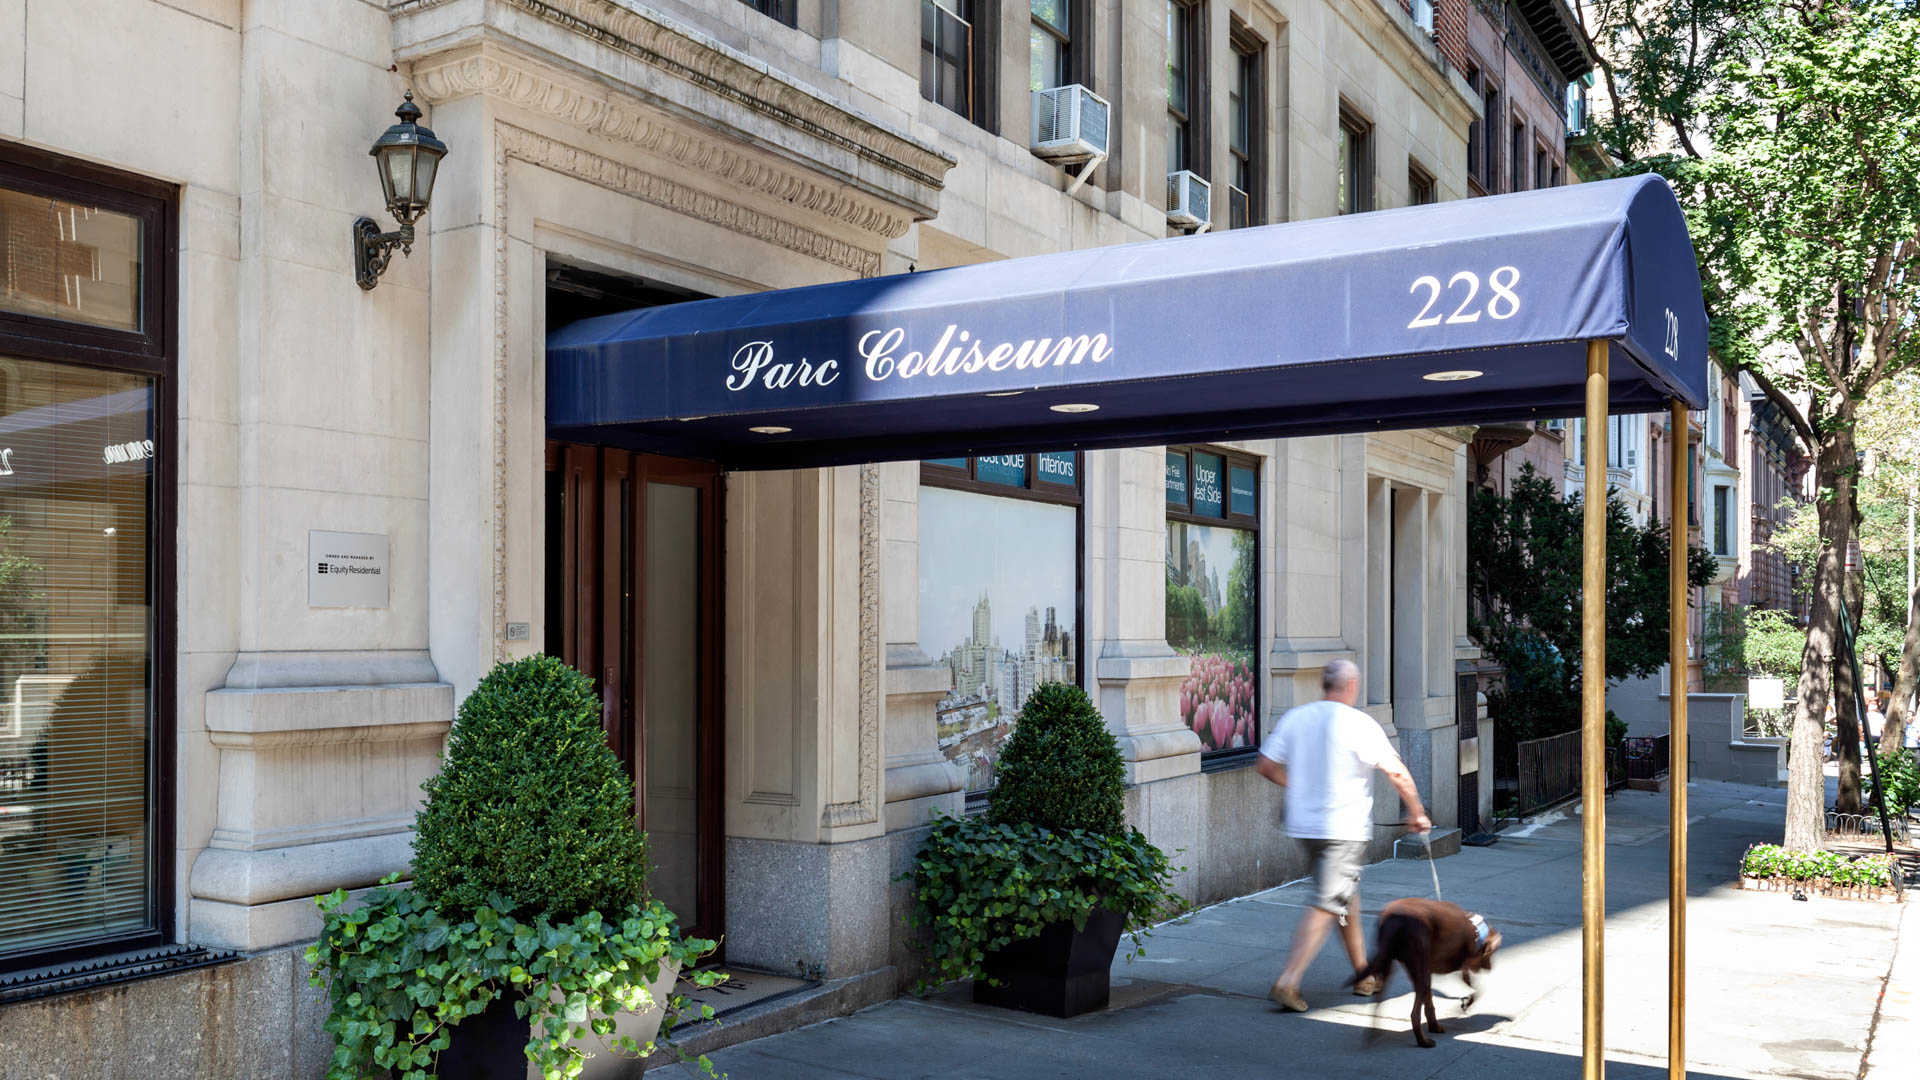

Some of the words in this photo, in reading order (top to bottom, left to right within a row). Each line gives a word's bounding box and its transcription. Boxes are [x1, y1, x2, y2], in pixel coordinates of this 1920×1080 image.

[1407, 266, 1521, 329] 228
[1665, 307, 1679, 361] 228
[726, 340, 839, 391] Parc
[858, 325, 1113, 381] Coliseum
[1039, 453, 1073, 477] Interiors
[1195, 463, 1217, 486] Upper
[1194, 484, 1206, 501] est
[1207, 485, 1222, 504] Side
